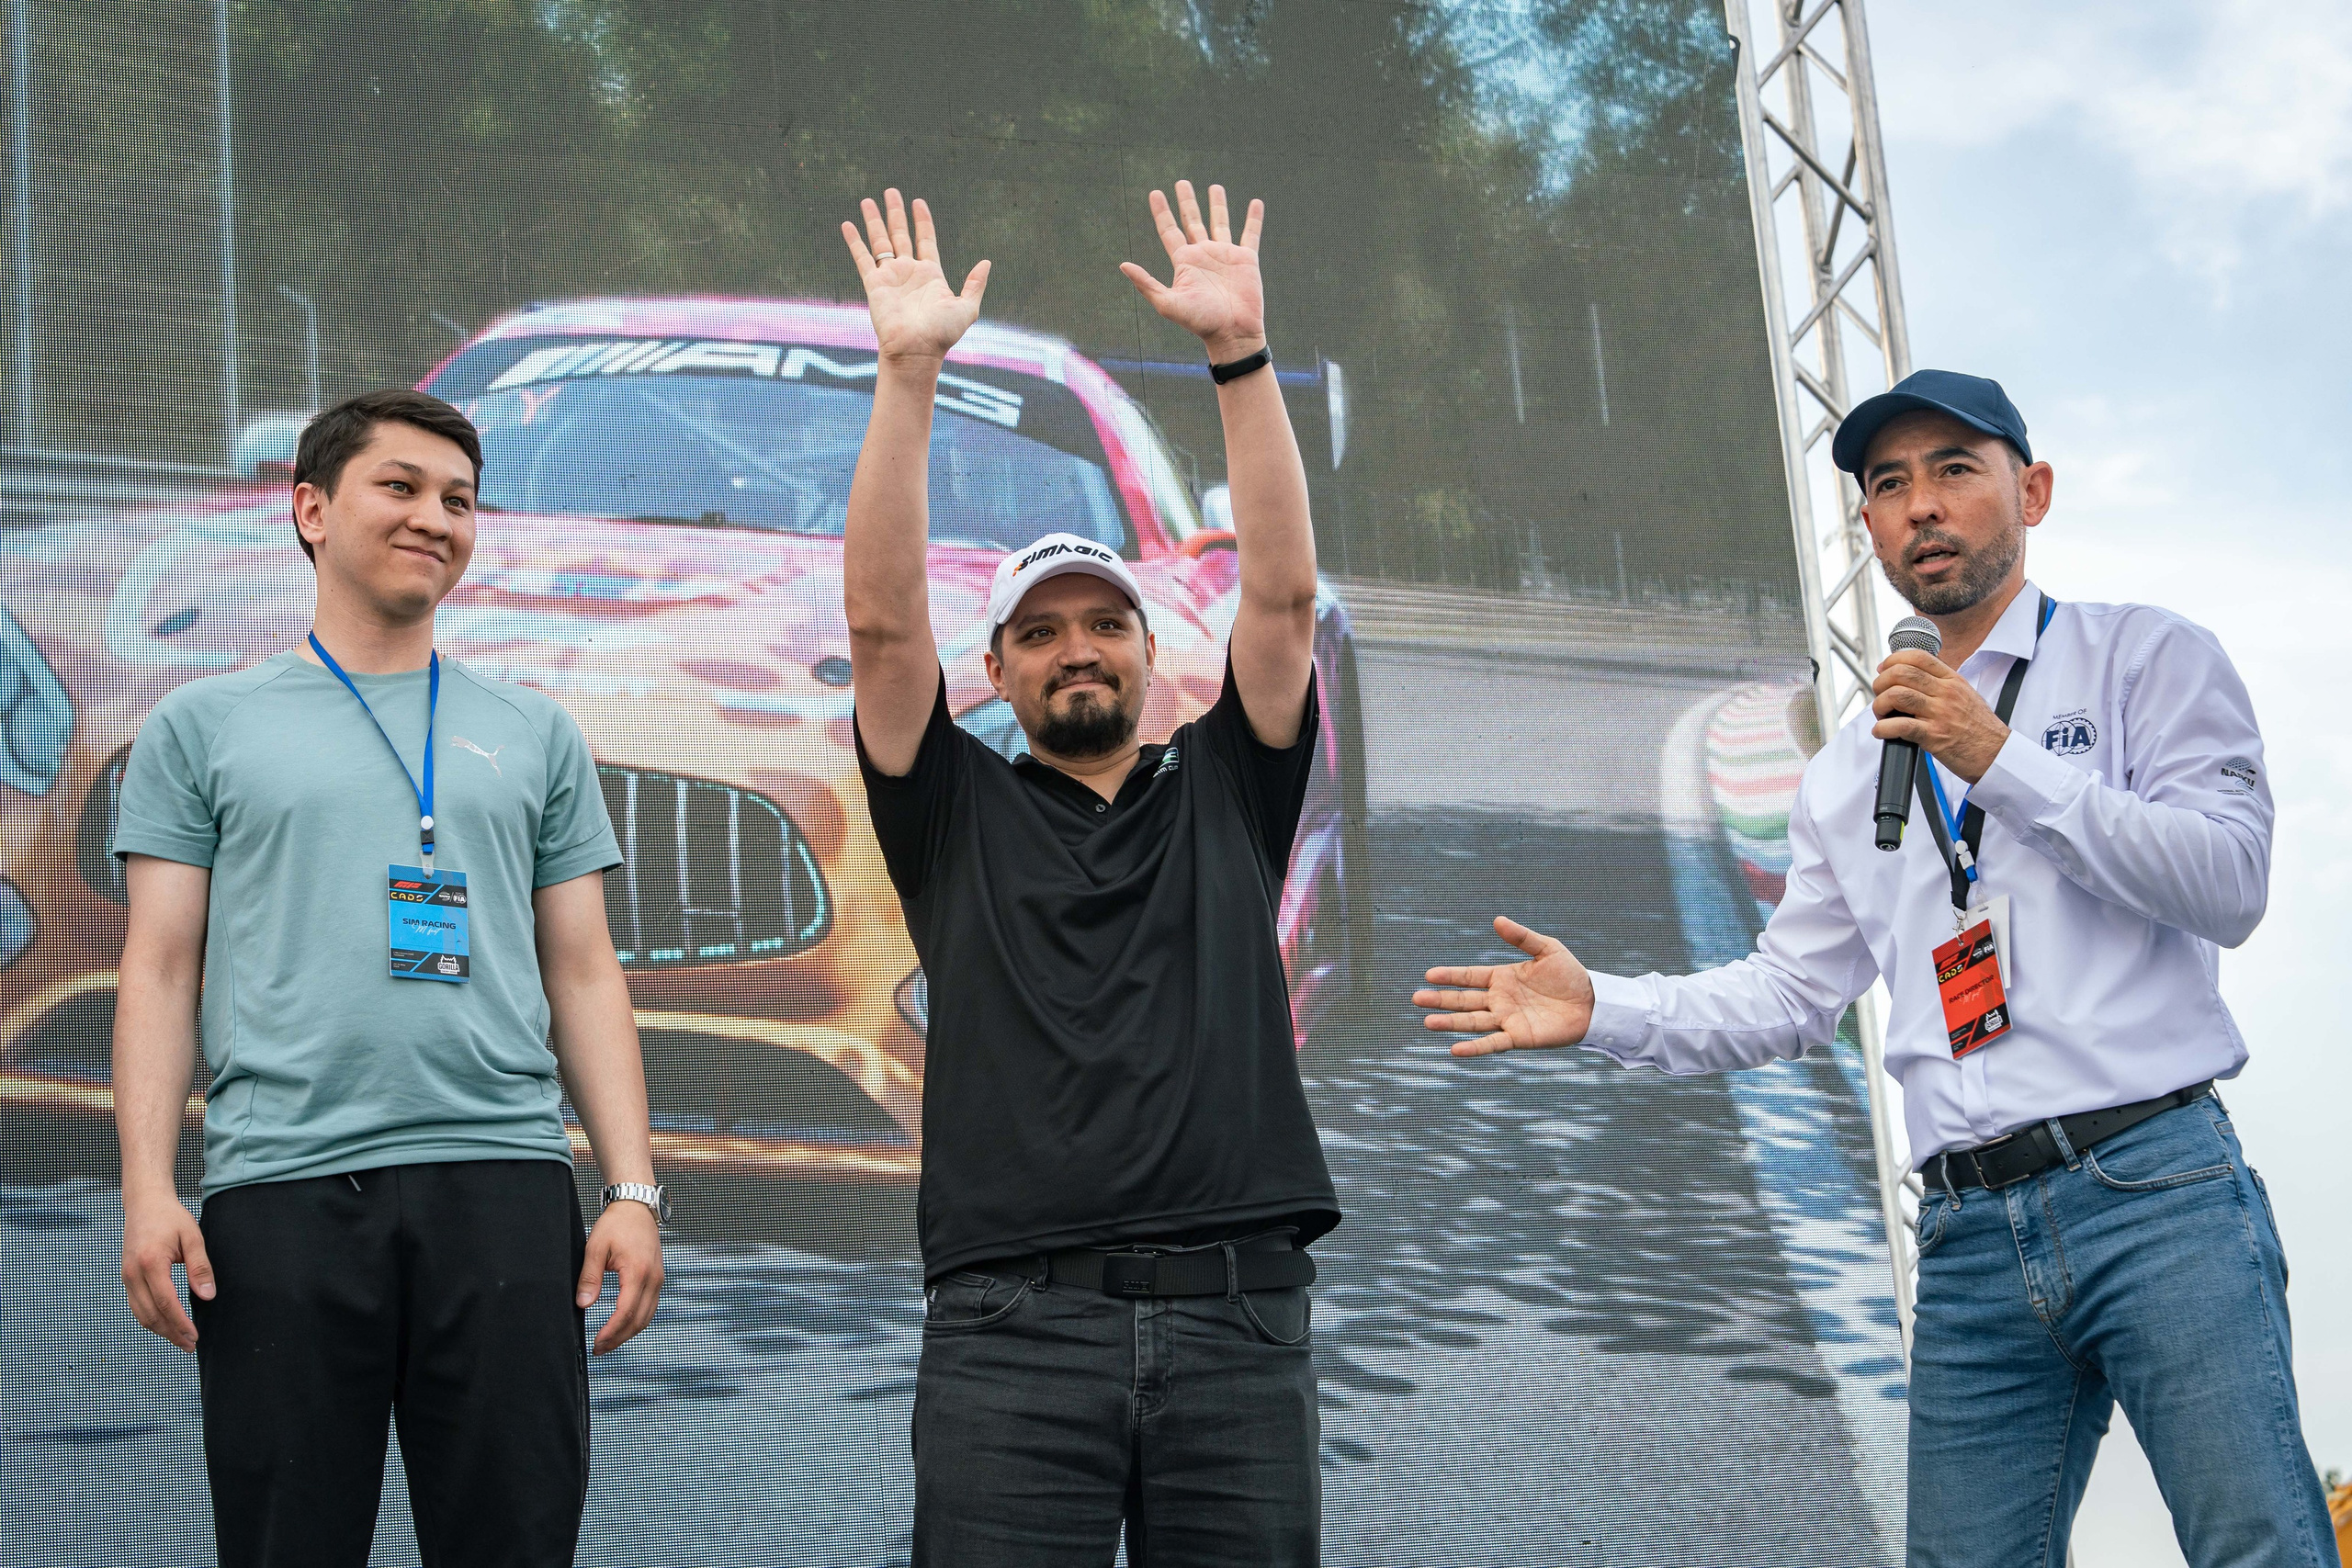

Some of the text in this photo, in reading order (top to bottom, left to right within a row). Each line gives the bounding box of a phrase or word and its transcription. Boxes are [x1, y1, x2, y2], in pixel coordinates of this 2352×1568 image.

[1012, 543, 1114, 577] SIMAGIC
[390, 891, 424, 902] CADS
[402, 918, 457, 930] SIM RACING
[438, 963, 459, 972] GORILLA
[1939, 964, 1963, 983] CADS
[1949, 991, 1965, 1004] RACE
[1964, 975, 1995, 995] DIRECTOR
